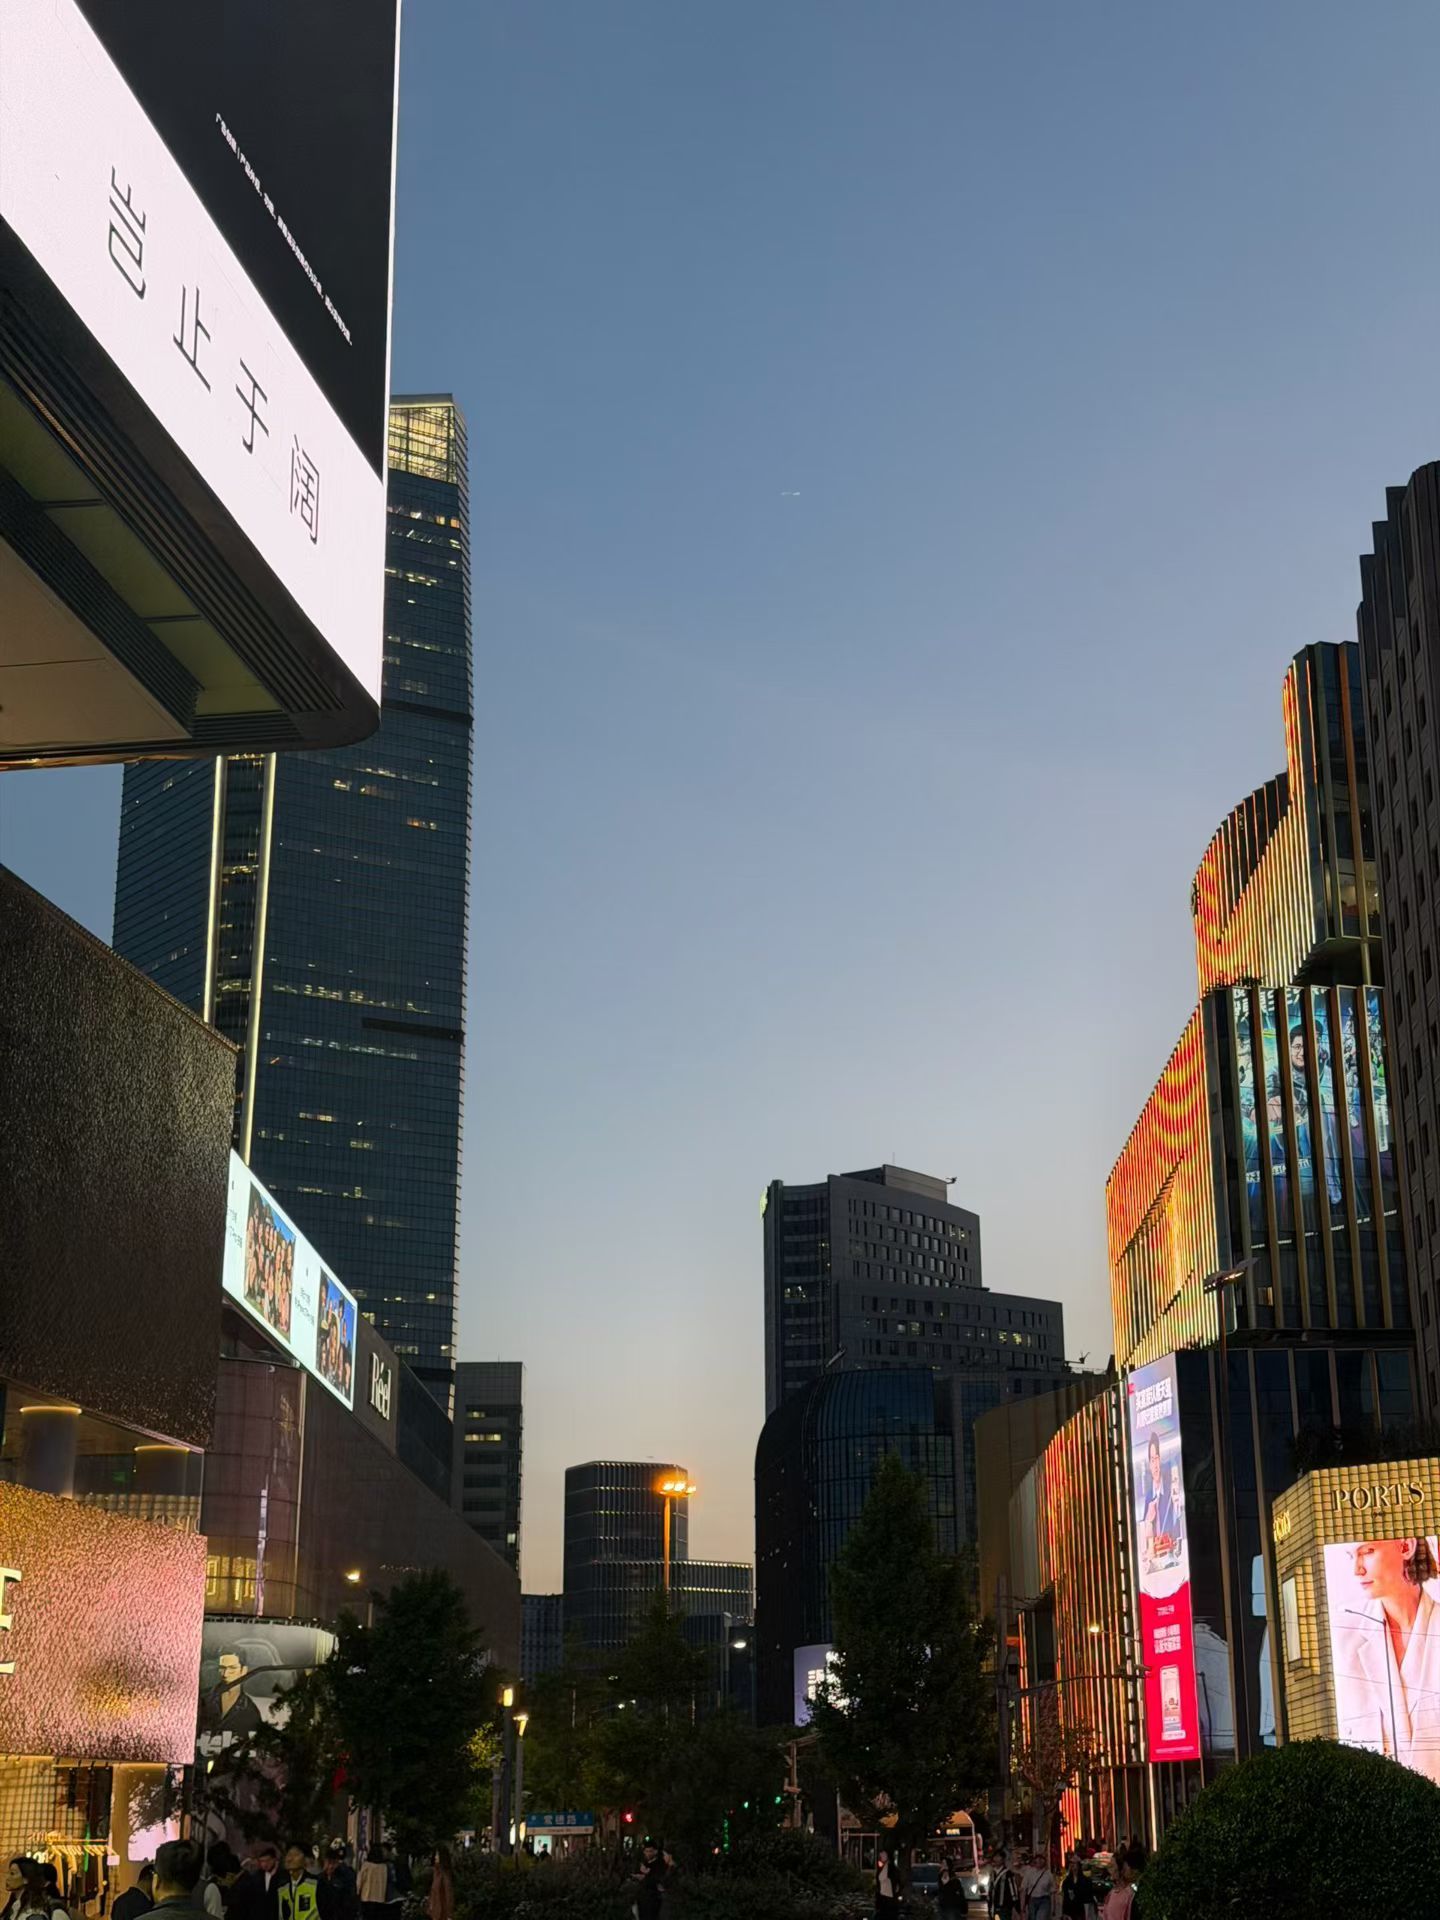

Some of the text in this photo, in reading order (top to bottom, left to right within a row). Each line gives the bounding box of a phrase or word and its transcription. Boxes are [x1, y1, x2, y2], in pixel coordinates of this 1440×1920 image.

[108, 165, 320, 545] 岂止于阔
[370, 1352, 392, 1421] Réel
[1332, 1482, 1425, 1513] PORTS
